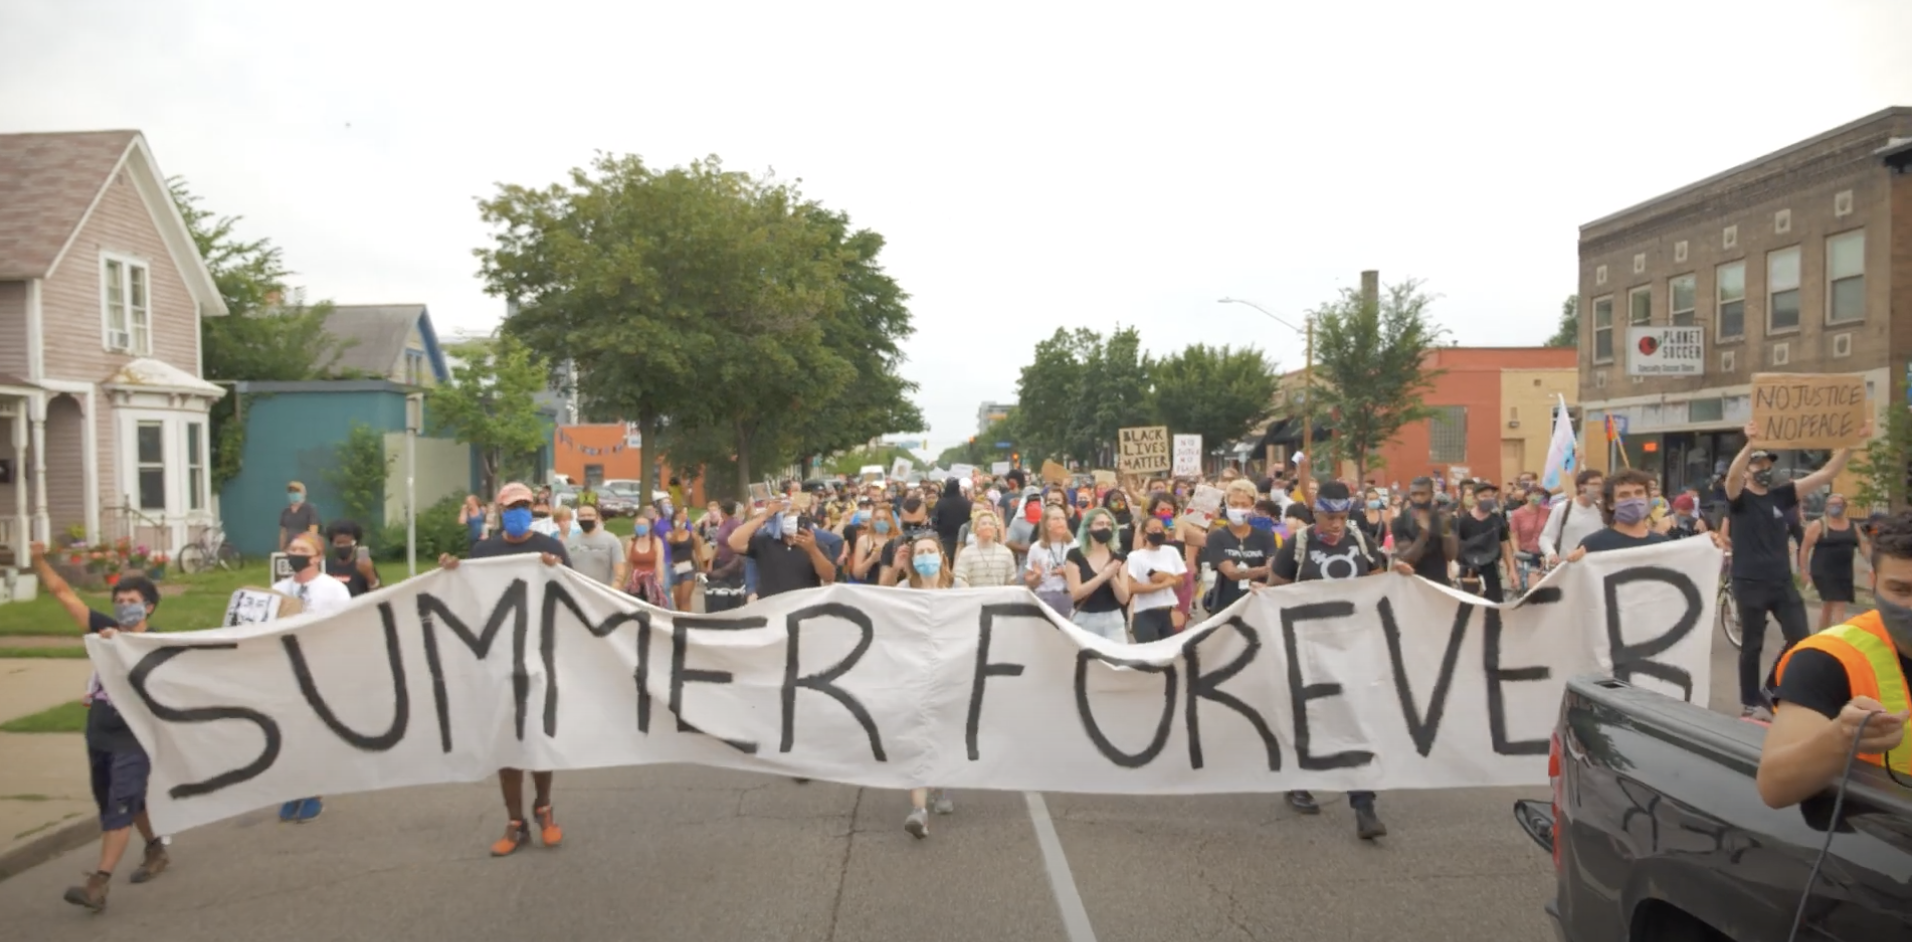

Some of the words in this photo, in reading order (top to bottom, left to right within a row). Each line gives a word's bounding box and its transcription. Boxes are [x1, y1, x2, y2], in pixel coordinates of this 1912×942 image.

[1663, 330, 1701, 344] PLANET
[1663, 345, 1702, 359] SOCCER
[1756, 385, 1790, 410] NO
[1792, 384, 1862, 410] JUSTICE
[1765, 415, 1797, 441] NO
[1798, 411, 1854, 438] PEACE
[1123, 428, 1163, 442] BLACK
[1123, 442, 1166, 456] LIVES
[1123, 456, 1168, 470] MATTER
[128, 577, 888, 800] SUMMER
[966, 566, 1703, 772] FOREVER
